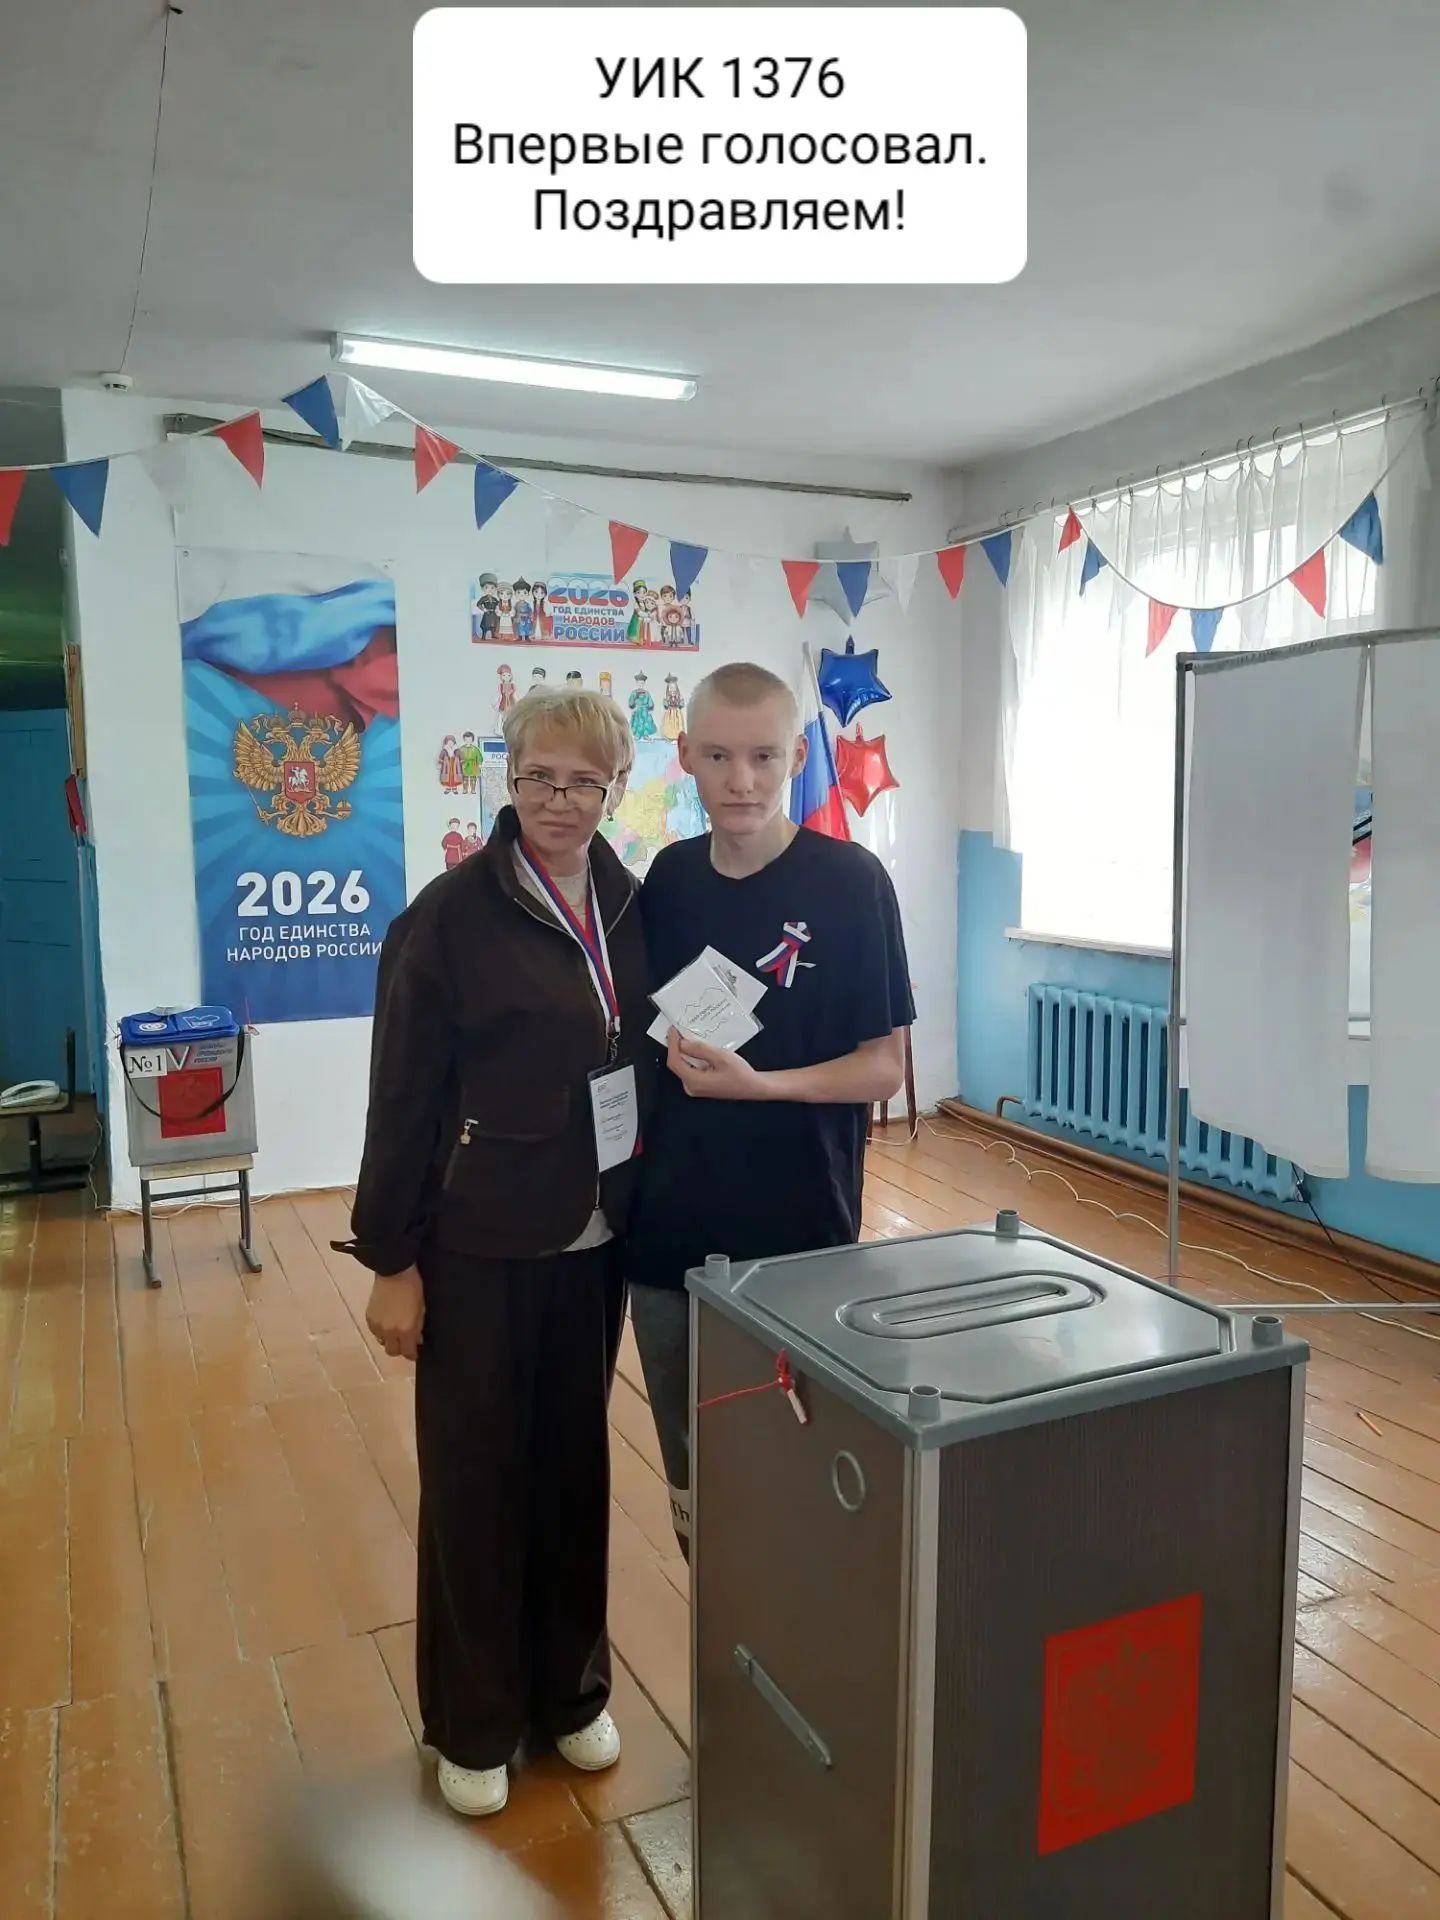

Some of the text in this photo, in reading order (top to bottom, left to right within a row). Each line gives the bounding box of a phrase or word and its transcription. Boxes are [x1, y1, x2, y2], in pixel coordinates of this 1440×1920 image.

[548, 577, 630, 608] 2026
[553, 606, 625, 616] ГОД ЕДИНСТВА
[563, 615, 615, 626] НАРОДОВ
[554, 626, 625, 642] РОССИИ
[236, 869, 371, 917] 2026
[239, 923, 371, 943] ГОД ЕДИНСТВА
[226, 941, 382, 962] НАРОДОВ РОССИИ
